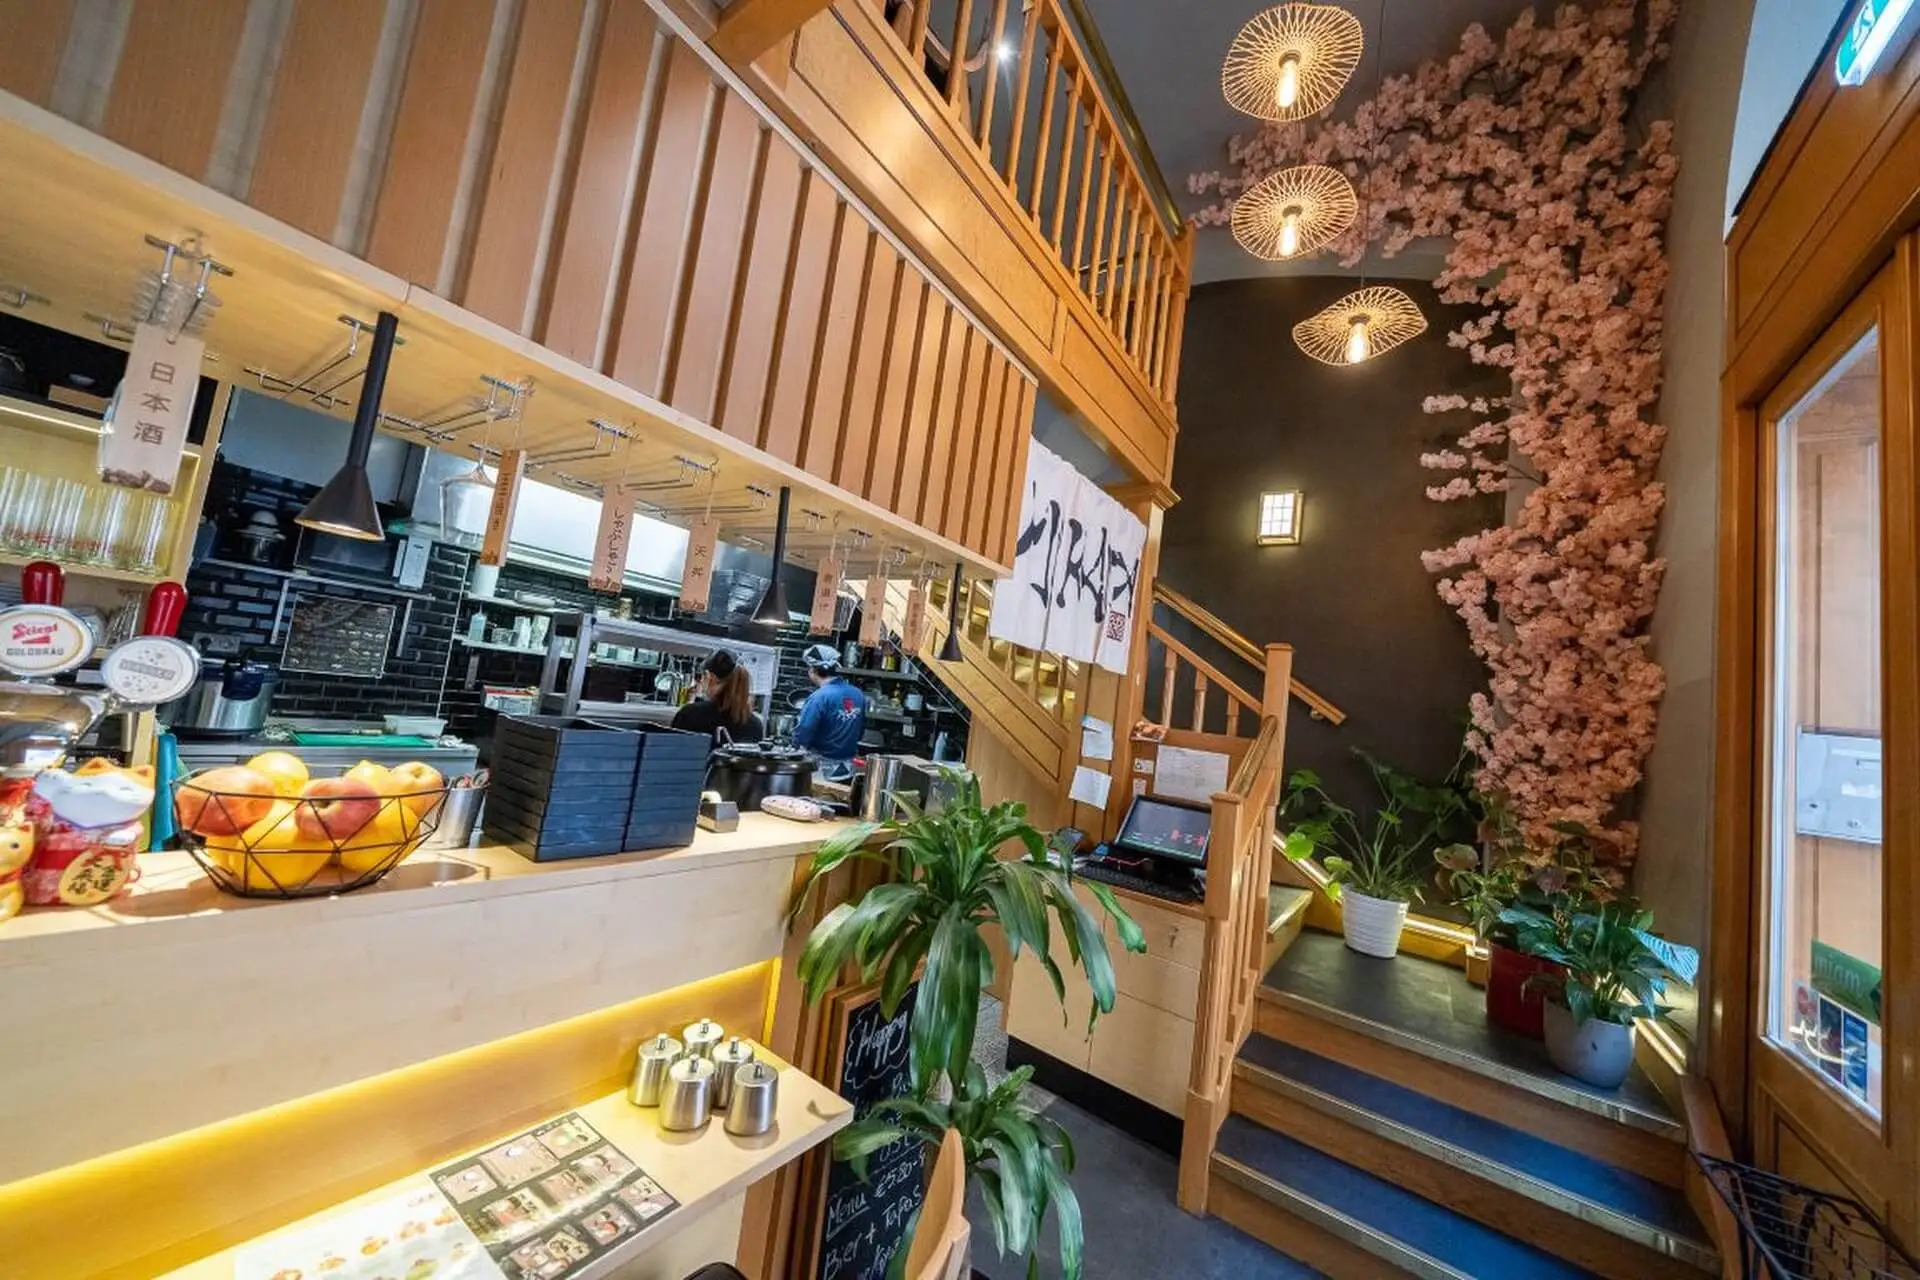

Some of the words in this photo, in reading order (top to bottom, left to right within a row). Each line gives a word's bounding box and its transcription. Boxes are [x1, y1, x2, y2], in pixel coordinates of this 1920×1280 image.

[132, 362, 176, 445] 日本酒
[827, 1192, 867, 1242] Menu
